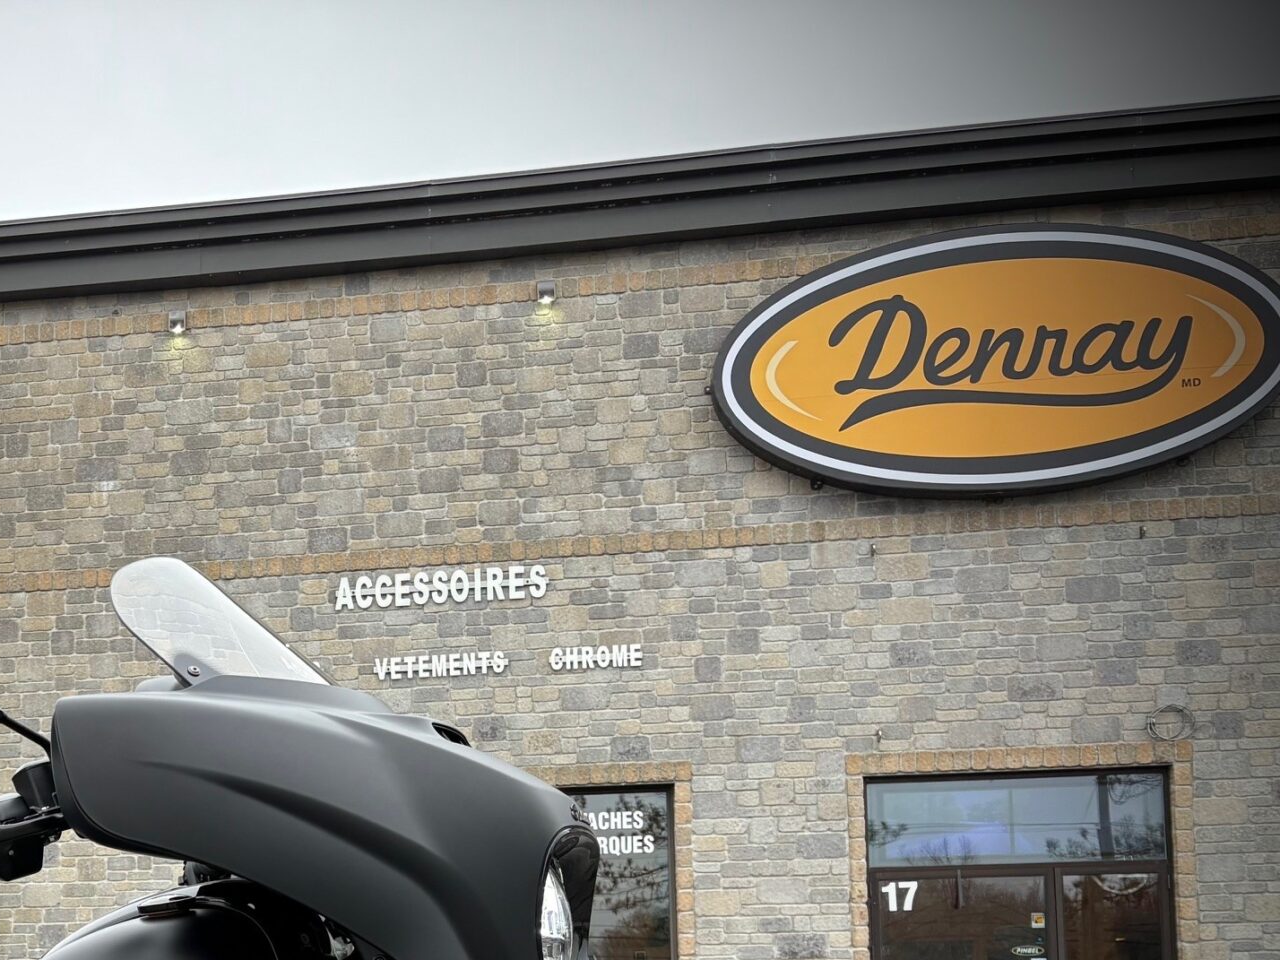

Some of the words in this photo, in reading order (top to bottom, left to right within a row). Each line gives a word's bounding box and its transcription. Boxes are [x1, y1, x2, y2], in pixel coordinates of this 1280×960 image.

[828, 294, 1194, 432] Denray
[1181, 377, 1202, 388] MD
[334, 564, 549, 612] ACCESSOIRES
[375, 651, 506, 680] VETEMENTS
[549, 643, 643, 671] CHROME
[583, 810, 644, 830] ACHES
[881, 881, 918, 911] 17
